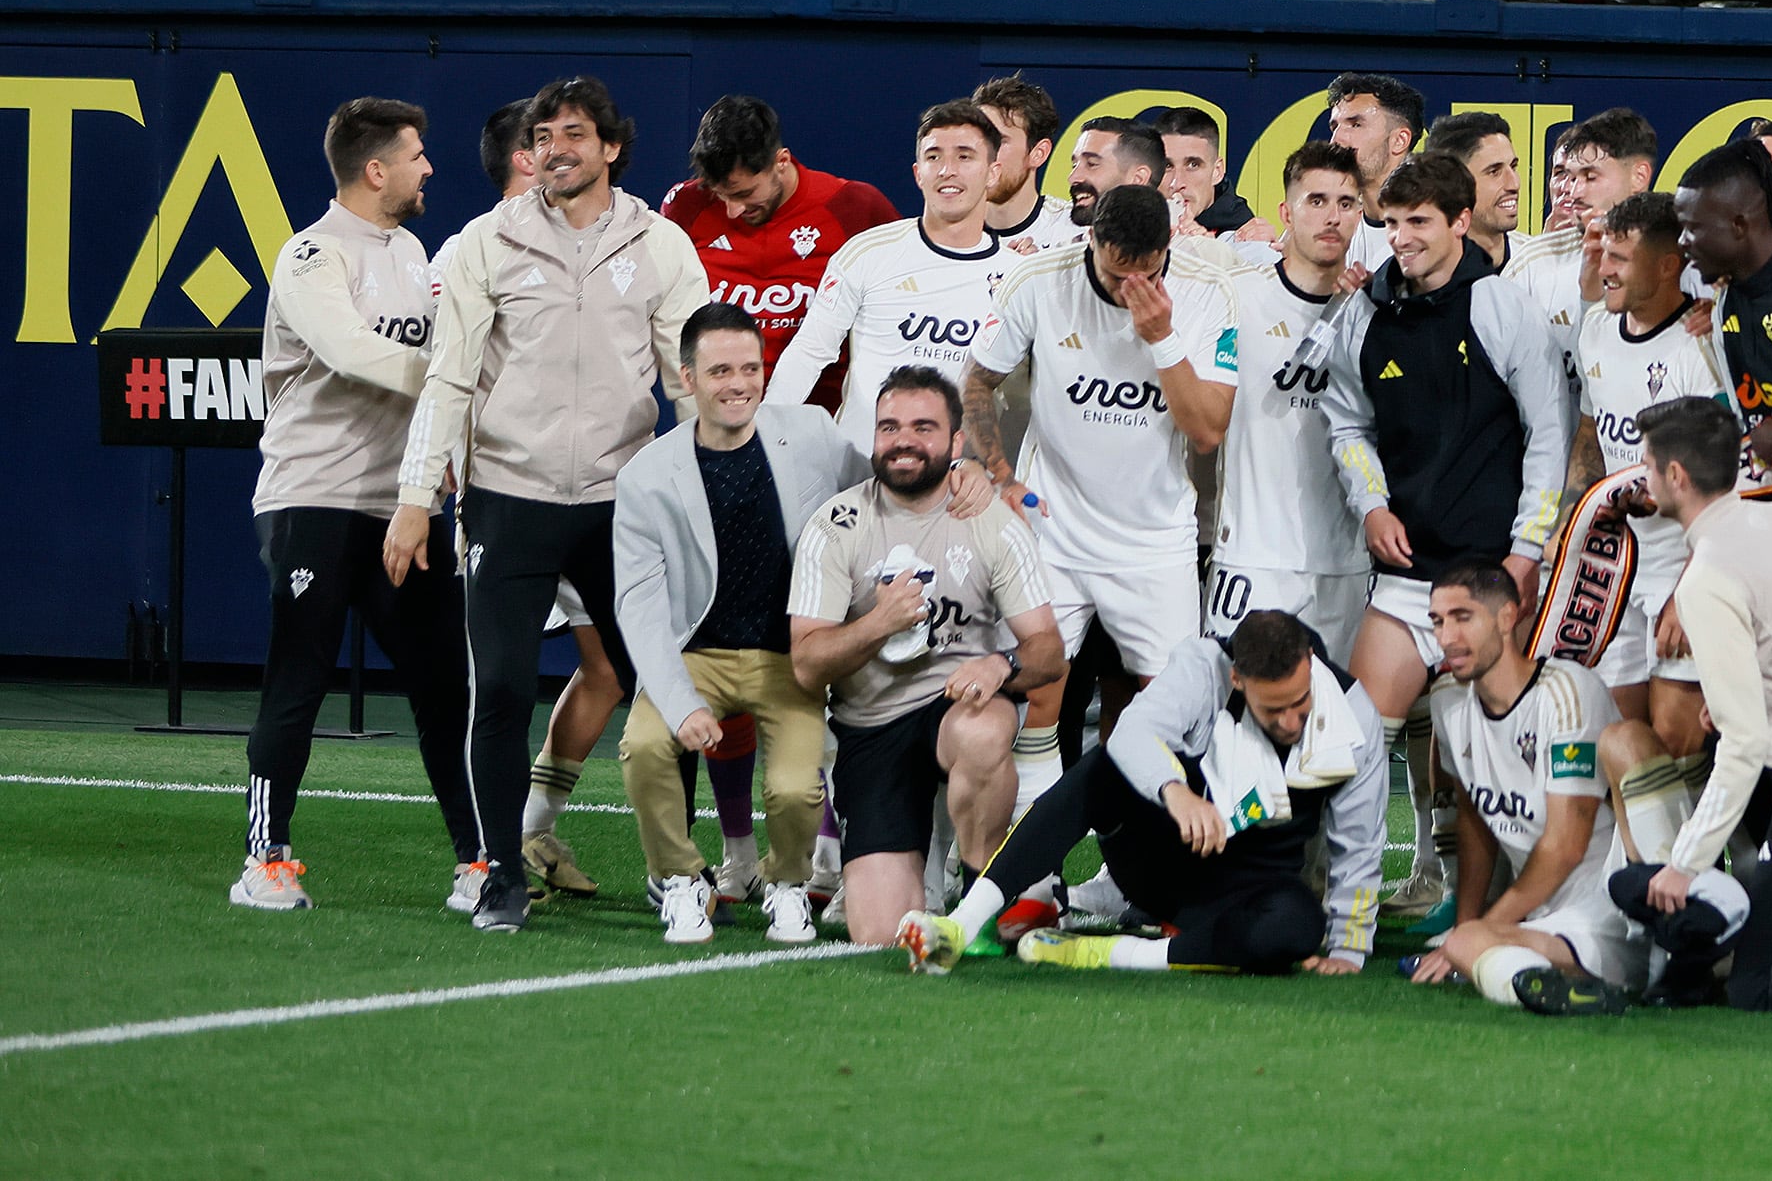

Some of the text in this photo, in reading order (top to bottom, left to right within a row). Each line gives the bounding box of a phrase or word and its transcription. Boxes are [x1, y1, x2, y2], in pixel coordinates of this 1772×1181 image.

[913, 346, 970, 363] ENERGÍ
[1066, 374, 1168, 413] iner
[1082, 409, 1150, 428] ENERGÍA
[1211, 569, 1253, 620] 10
